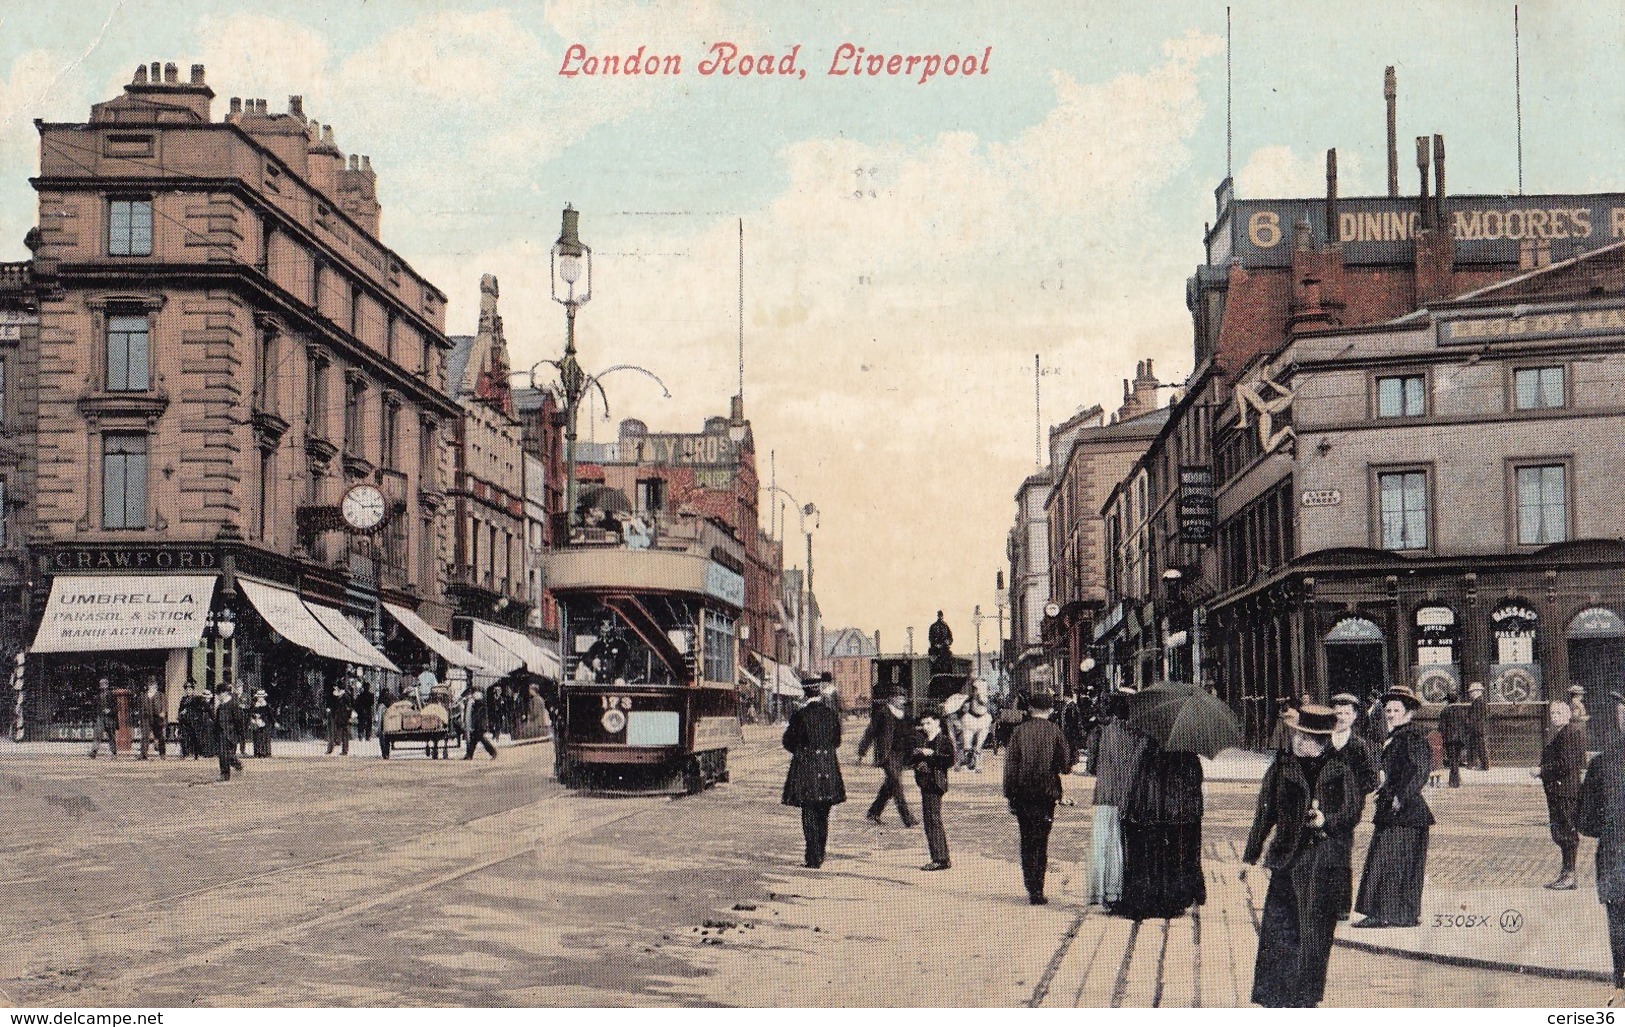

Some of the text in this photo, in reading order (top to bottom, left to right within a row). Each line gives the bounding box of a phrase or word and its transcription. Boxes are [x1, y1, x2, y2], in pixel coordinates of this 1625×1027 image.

[1248, 211, 1282, 248] 6
[1536, 314, 1572, 333] OF
[55, 551, 215, 568] CRAWFORD
[53, 611, 124, 622] PARASOL
[130, 611, 140, 621] &
[1519, 630, 1536, 638] ALE
